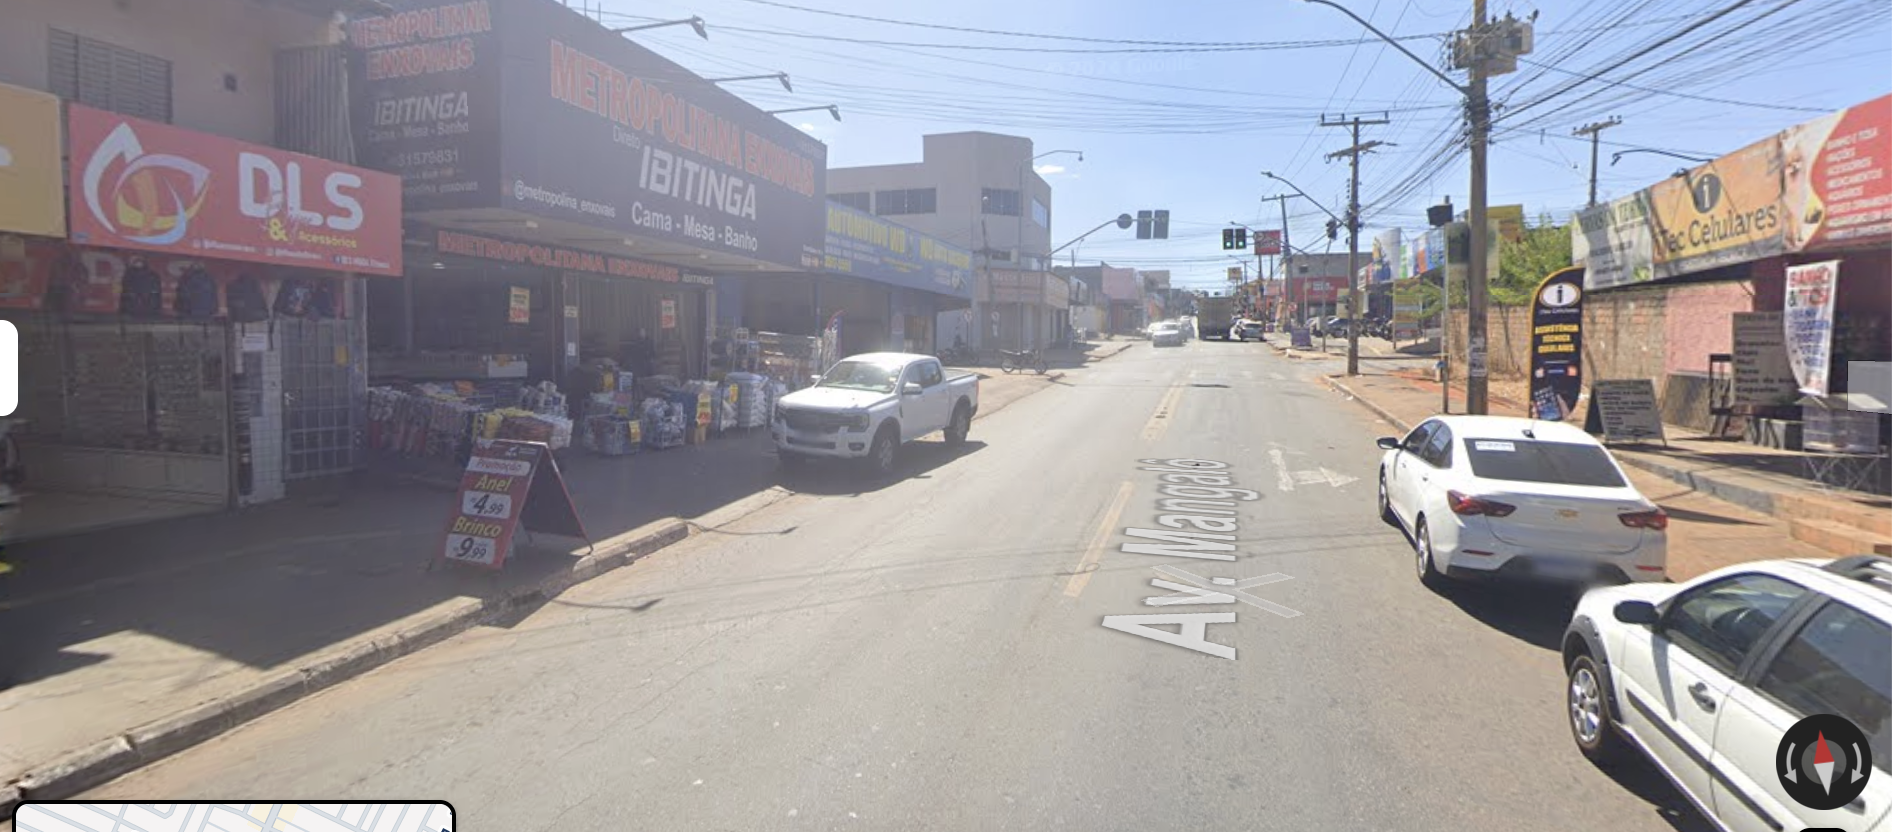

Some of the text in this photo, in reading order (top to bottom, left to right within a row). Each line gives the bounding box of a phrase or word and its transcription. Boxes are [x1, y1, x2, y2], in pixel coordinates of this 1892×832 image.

[375, 91, 468, 127] IBITINGA
[550, 38, 816, 198] METROPOLITANA ENXOVAIS
[238, 152, 364, 231] DLS
[639, 145, 757, 222] IBITINGA
[631, 202, 672, 232] Cama
[684, 215, 715, 244] Mesa
[724, 225, 758, 253] Banho
[1688, 204, 1779, 248] Celulares
[437, 229, 606, 276] METROPOLITANA
[474, 474, 513, 493] Anel
[452, 516, 503, 539] Brinco
